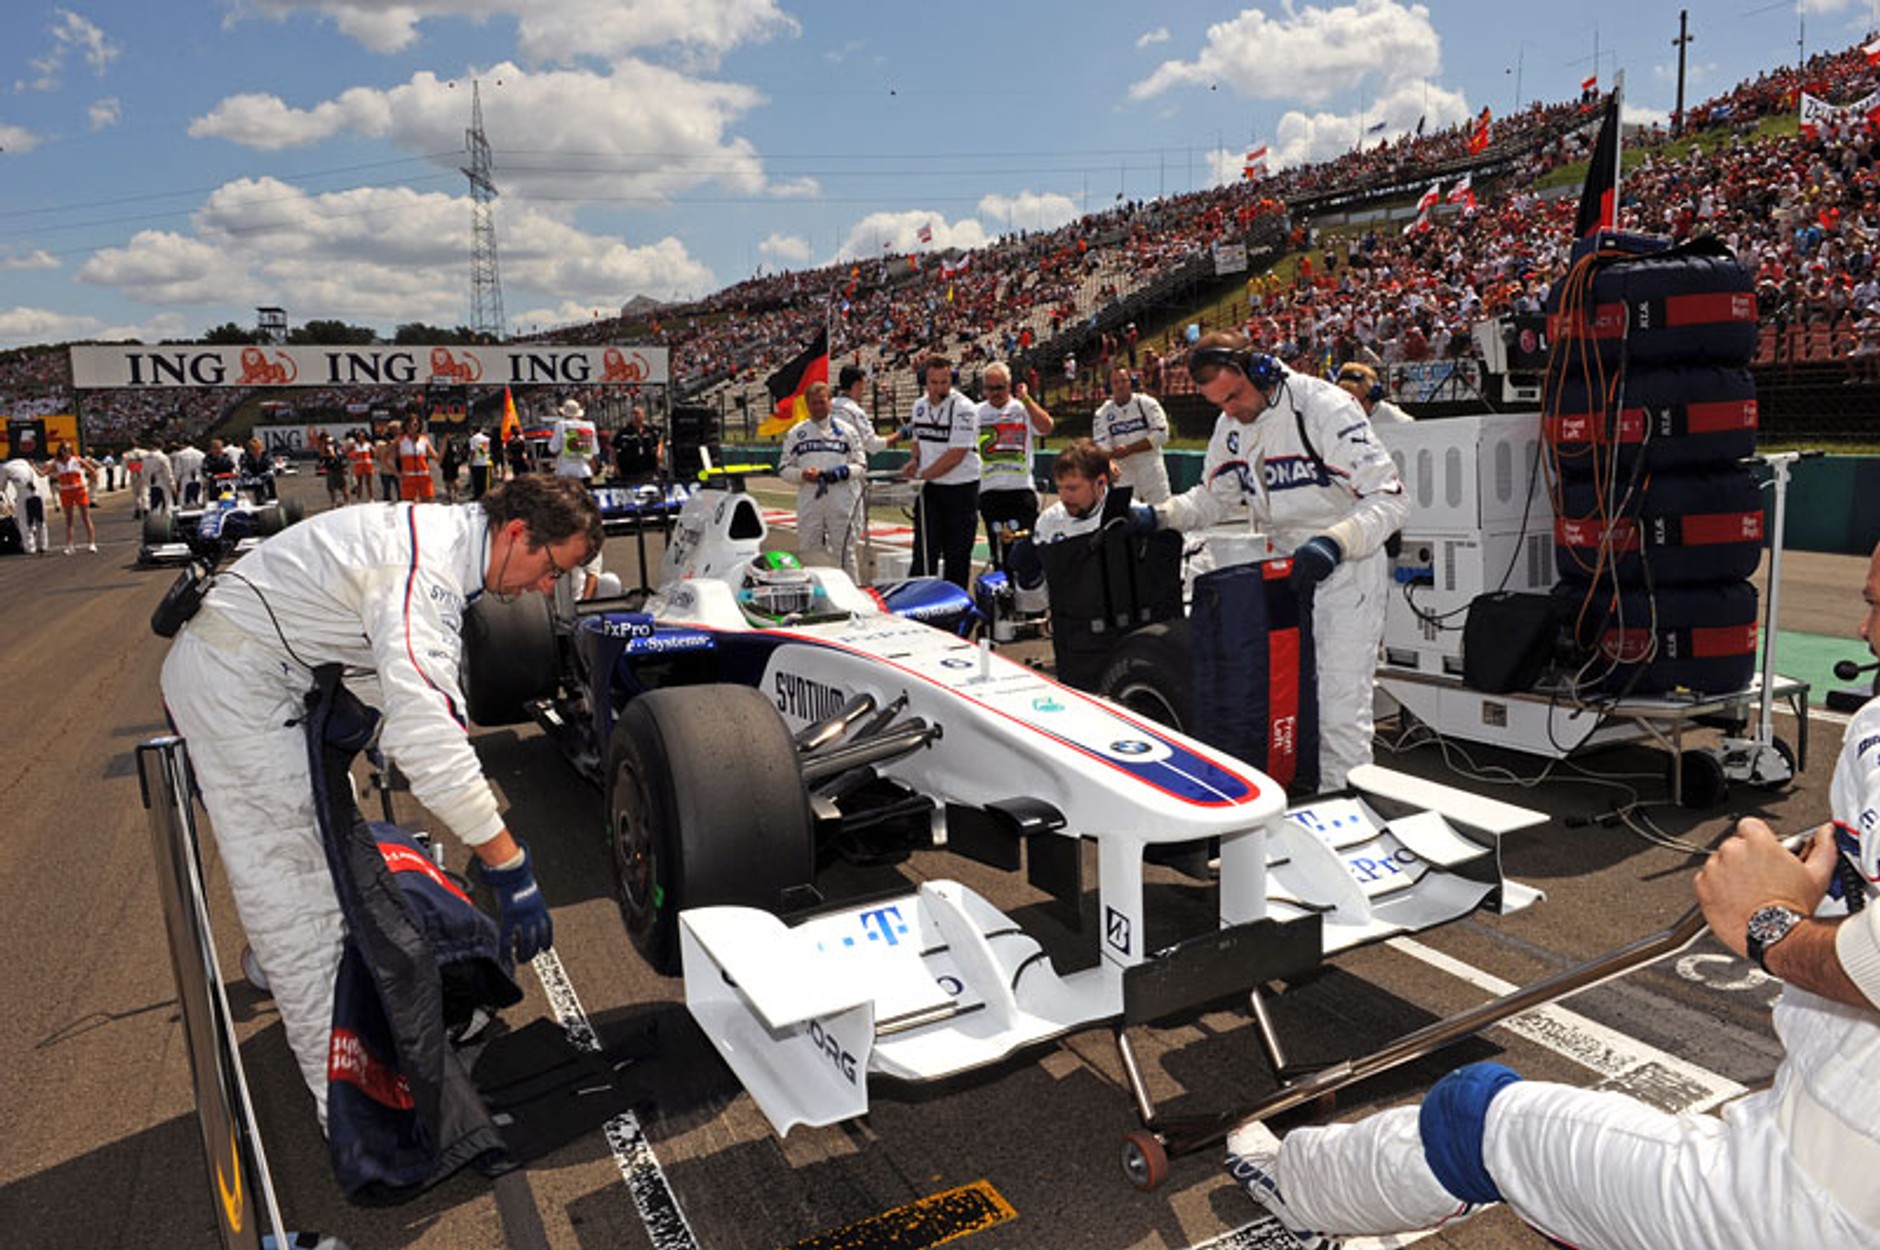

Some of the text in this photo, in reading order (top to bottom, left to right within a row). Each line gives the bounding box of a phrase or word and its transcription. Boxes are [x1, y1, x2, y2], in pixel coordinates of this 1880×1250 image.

[126, 353, 227, 384] ING
[326, 353, 418, 383] ING
[508, 353, 591, 382] ING
